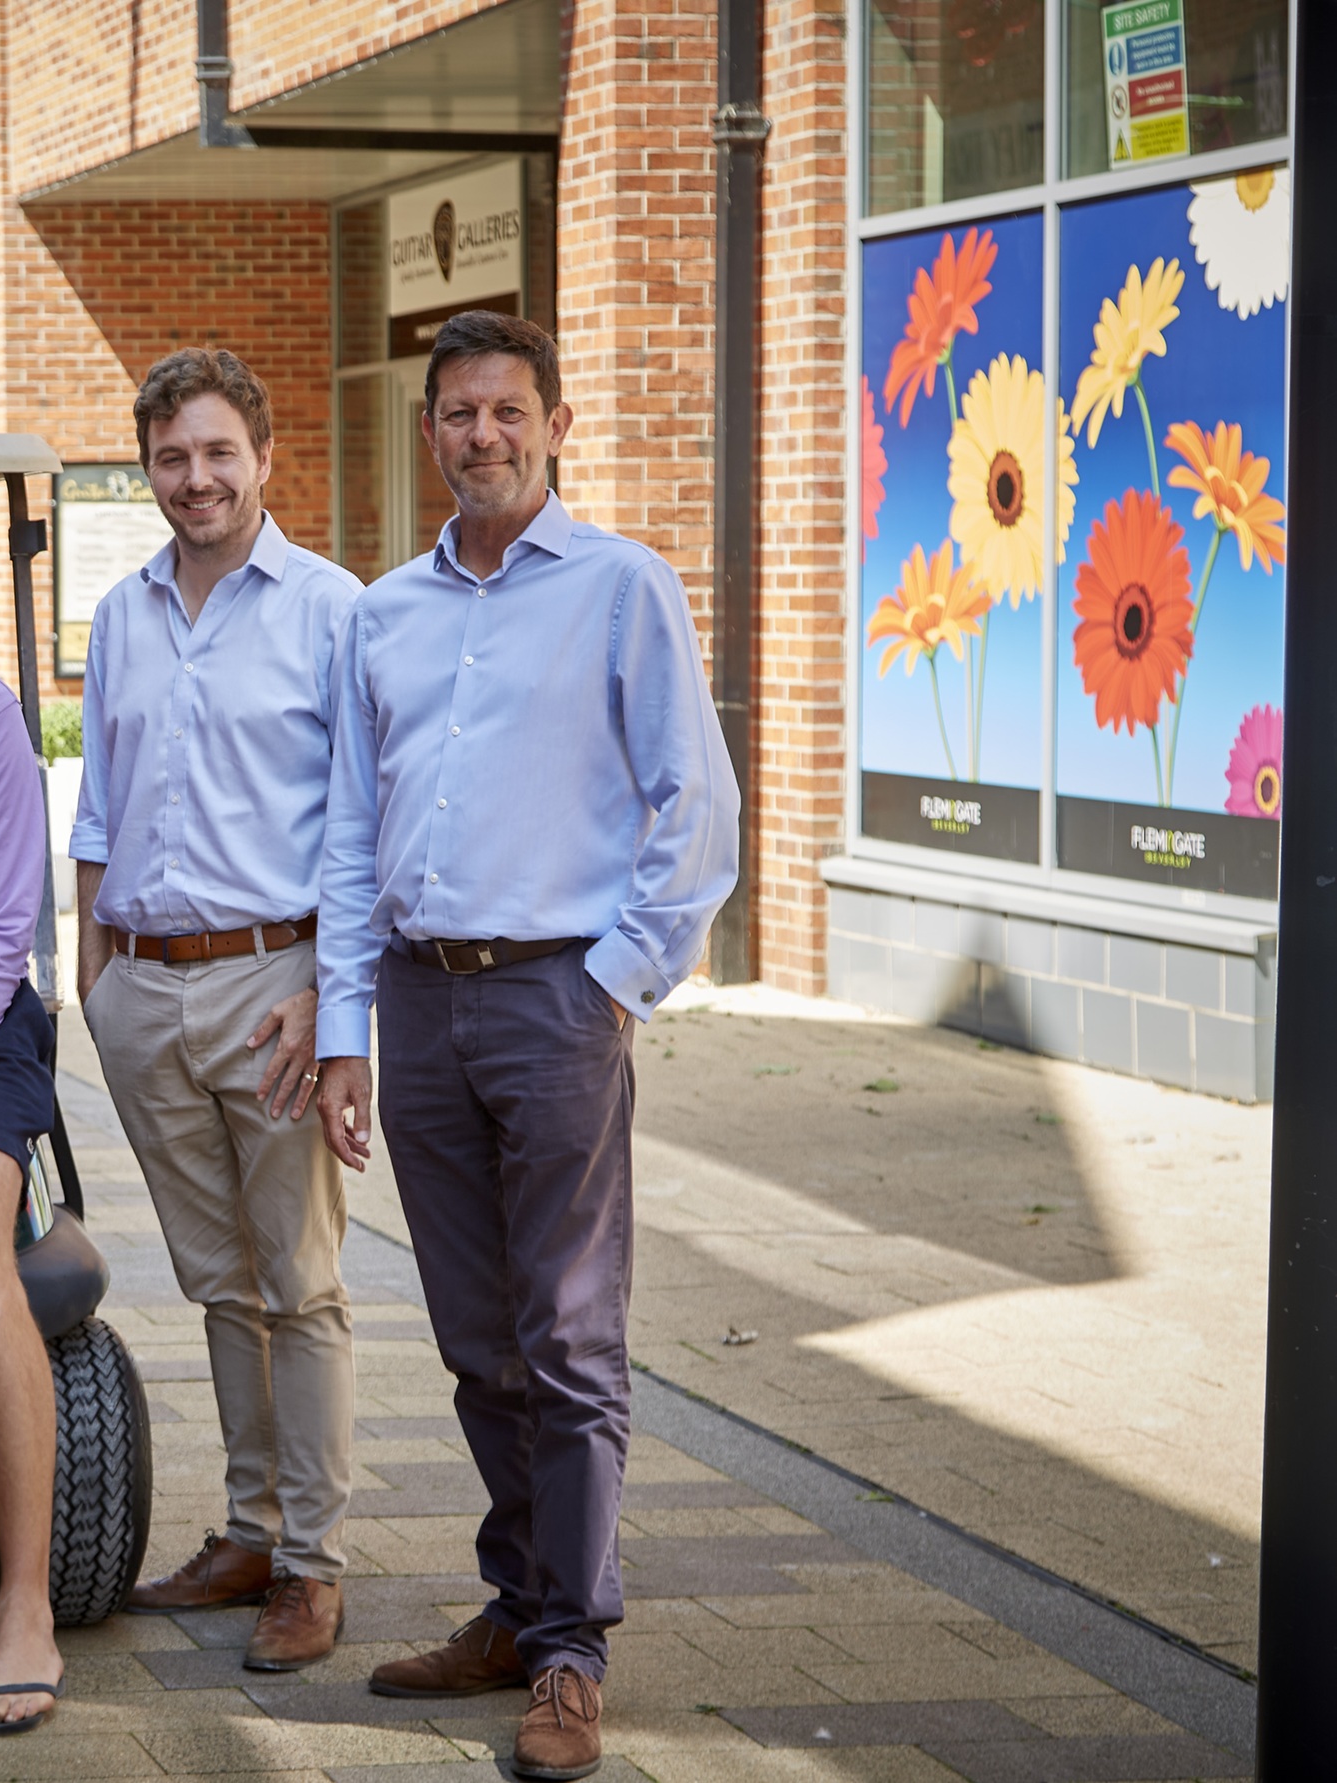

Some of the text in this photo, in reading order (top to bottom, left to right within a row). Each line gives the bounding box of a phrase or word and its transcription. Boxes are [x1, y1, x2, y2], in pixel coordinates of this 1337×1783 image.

[1113, 1, 1170, 32] SITE SAFETY
[392, 232, 434, 267] GUITAR
[457, 208, 521, 251] GALLERIES
[931, 818, 970, 834] BEVERLEY
[1144, 851, 1192, 869] BEVERLEY
